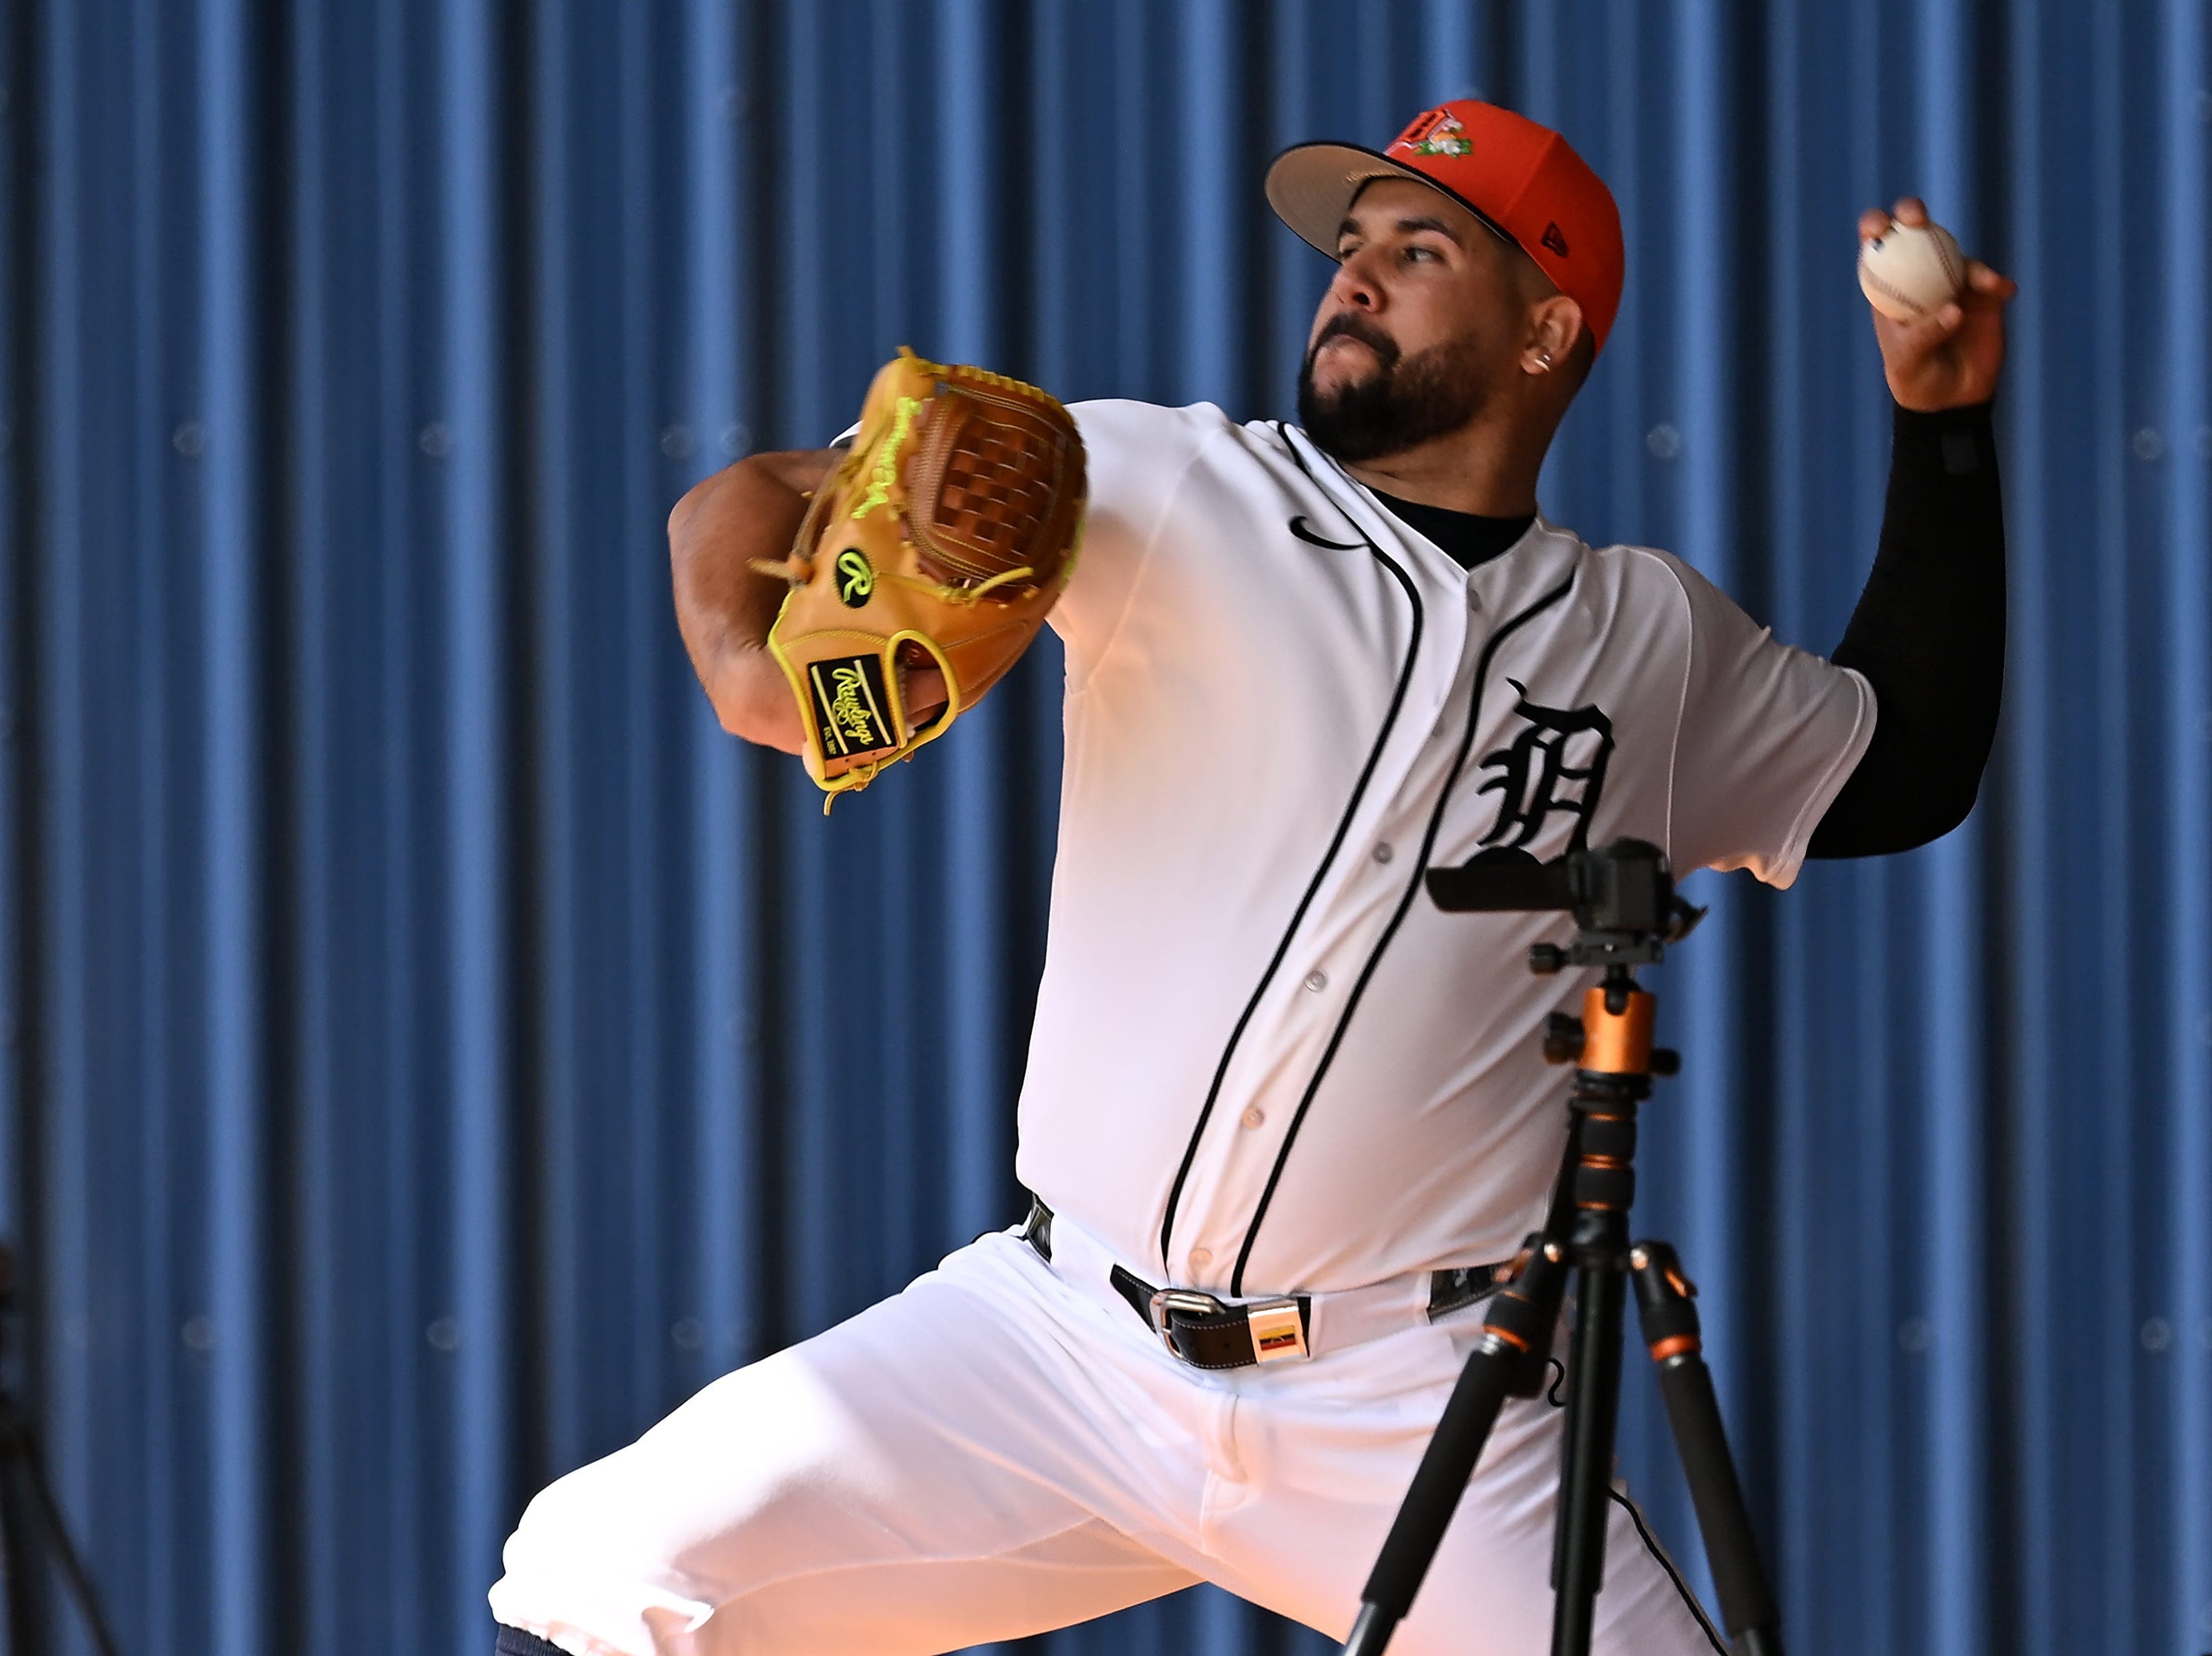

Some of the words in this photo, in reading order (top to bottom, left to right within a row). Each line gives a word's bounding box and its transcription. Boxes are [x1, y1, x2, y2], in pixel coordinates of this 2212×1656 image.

[838, 551, 872, 603] R
[831, 668, 874, 745] Rawlings
[1474, 677, 1615, 865] D
